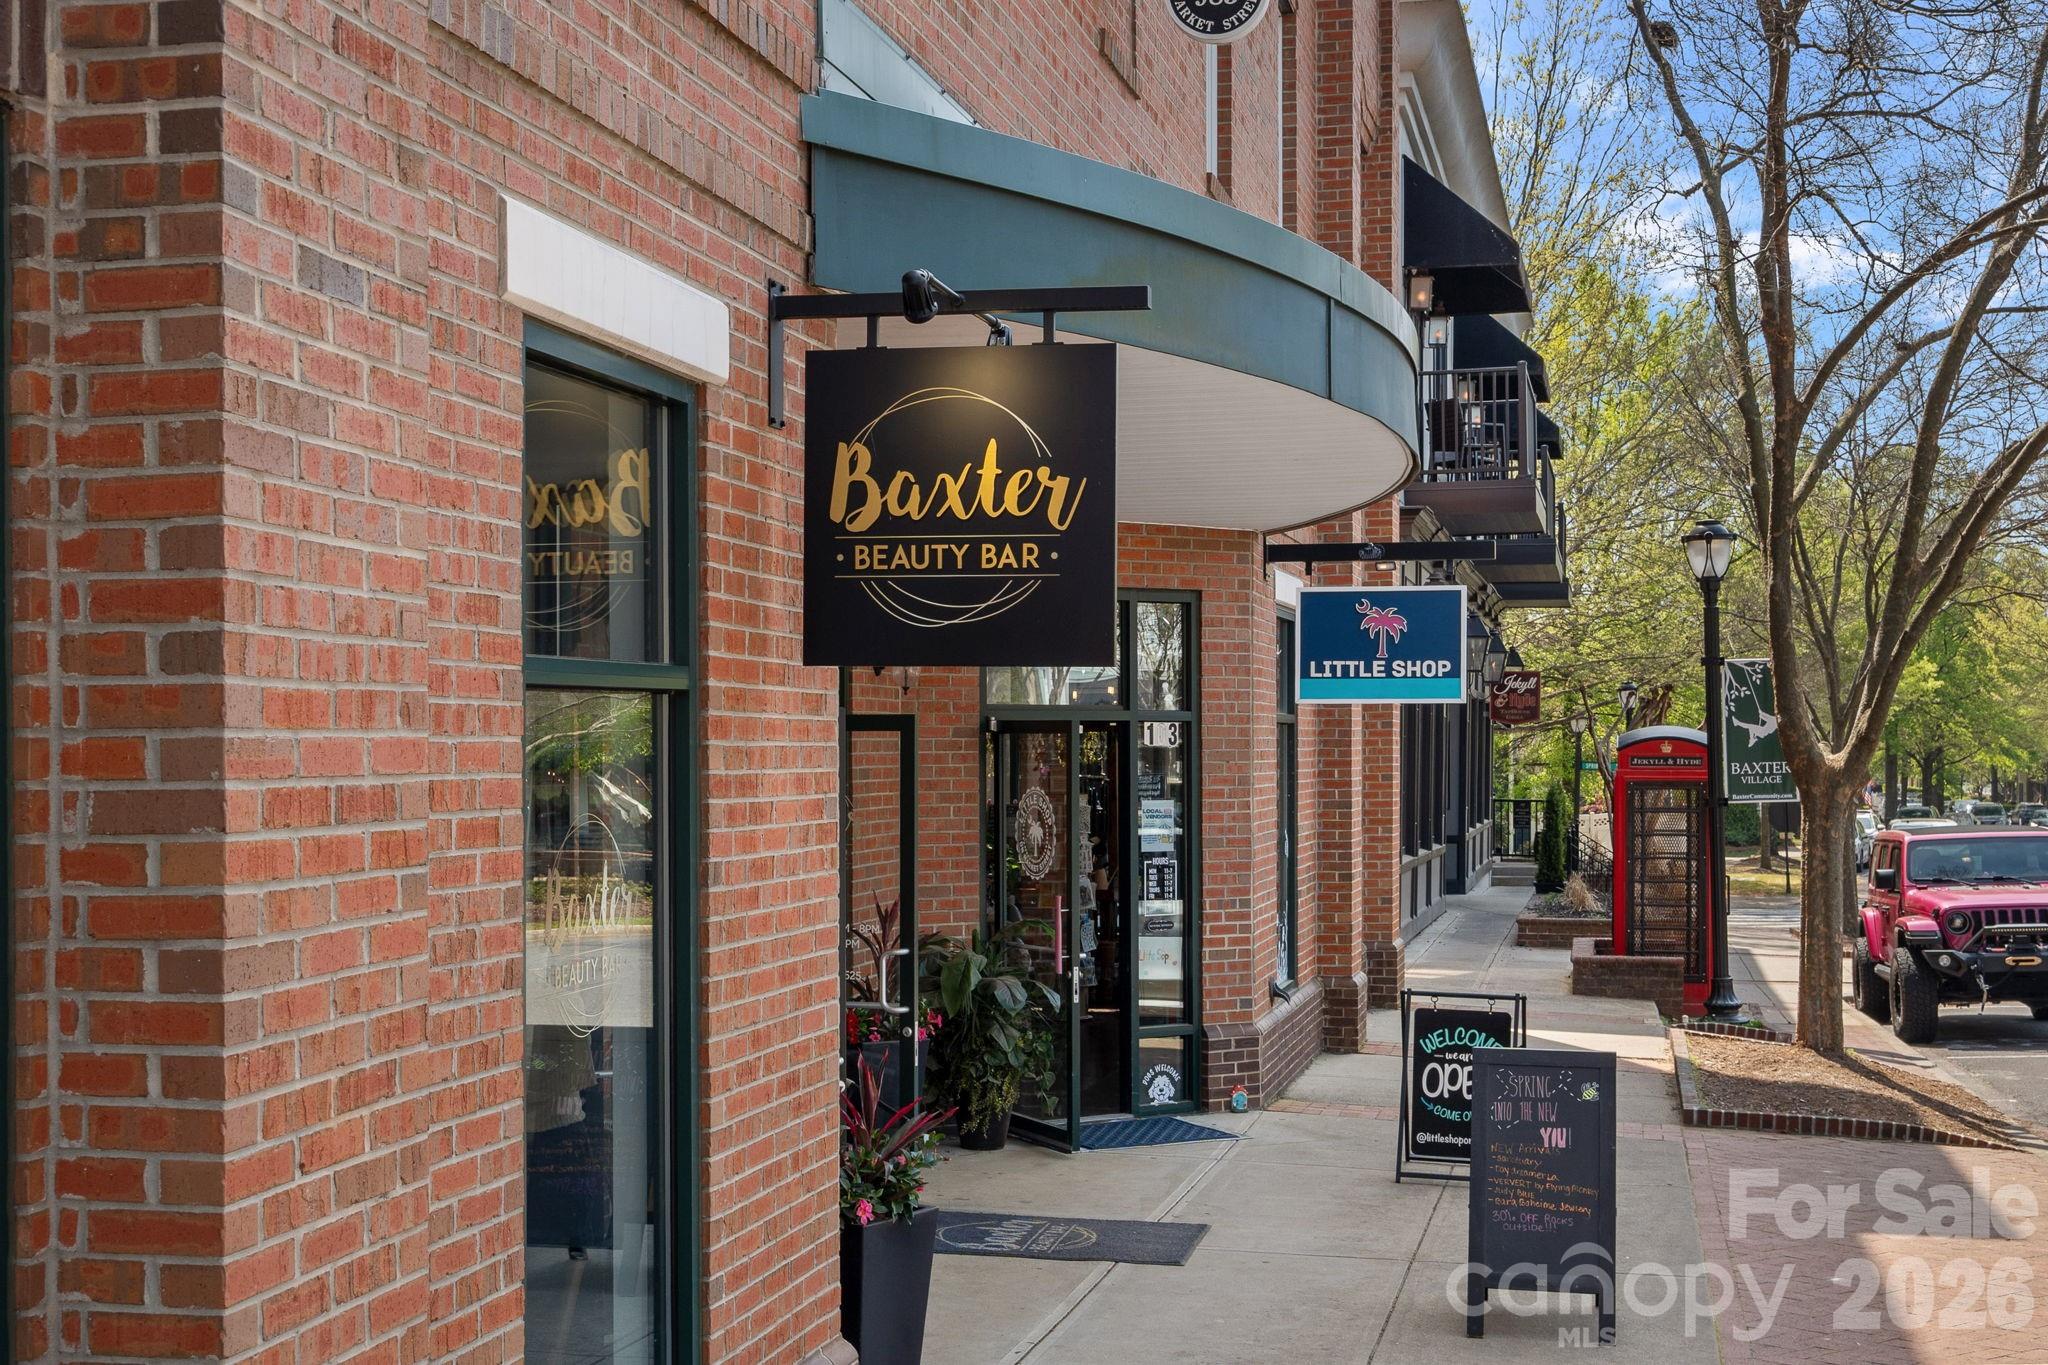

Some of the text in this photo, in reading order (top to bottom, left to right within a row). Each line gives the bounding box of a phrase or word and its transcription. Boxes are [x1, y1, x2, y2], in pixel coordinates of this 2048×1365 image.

[1174, 0, 1258, 32] ARKET STRE
[829, 438, 1087, 533] Baxter
[854, 543, 1040, 570] BEAUTY BAR
[1309, 659, 1452, 678] LITTLE SHOP
[1493, 673, 1538, 695] Jekyll
[1740, 775, 1783, 784] VILLAGE
[1732, 792, 1793, 800] BaxterCommunity.com
[543, 858, 640, 954] Baxter
[859, 924, 880, 934] 8PM
[845, 940, 860, 949] PM
[554, 957, 599, 989] BEAUTY
[1142, 1063, 1182, 1086] DOGS WELCOME
[1421, 1062, 1473, 1100] OPE
[1509, 1075, 1552, 1099] SPRING
[1433, 1105, 1462, 1121] COME
[1493, 1101, 1559, 1123] INTO THE NEW
[1519, 1212, 1540, 1224] OFF
